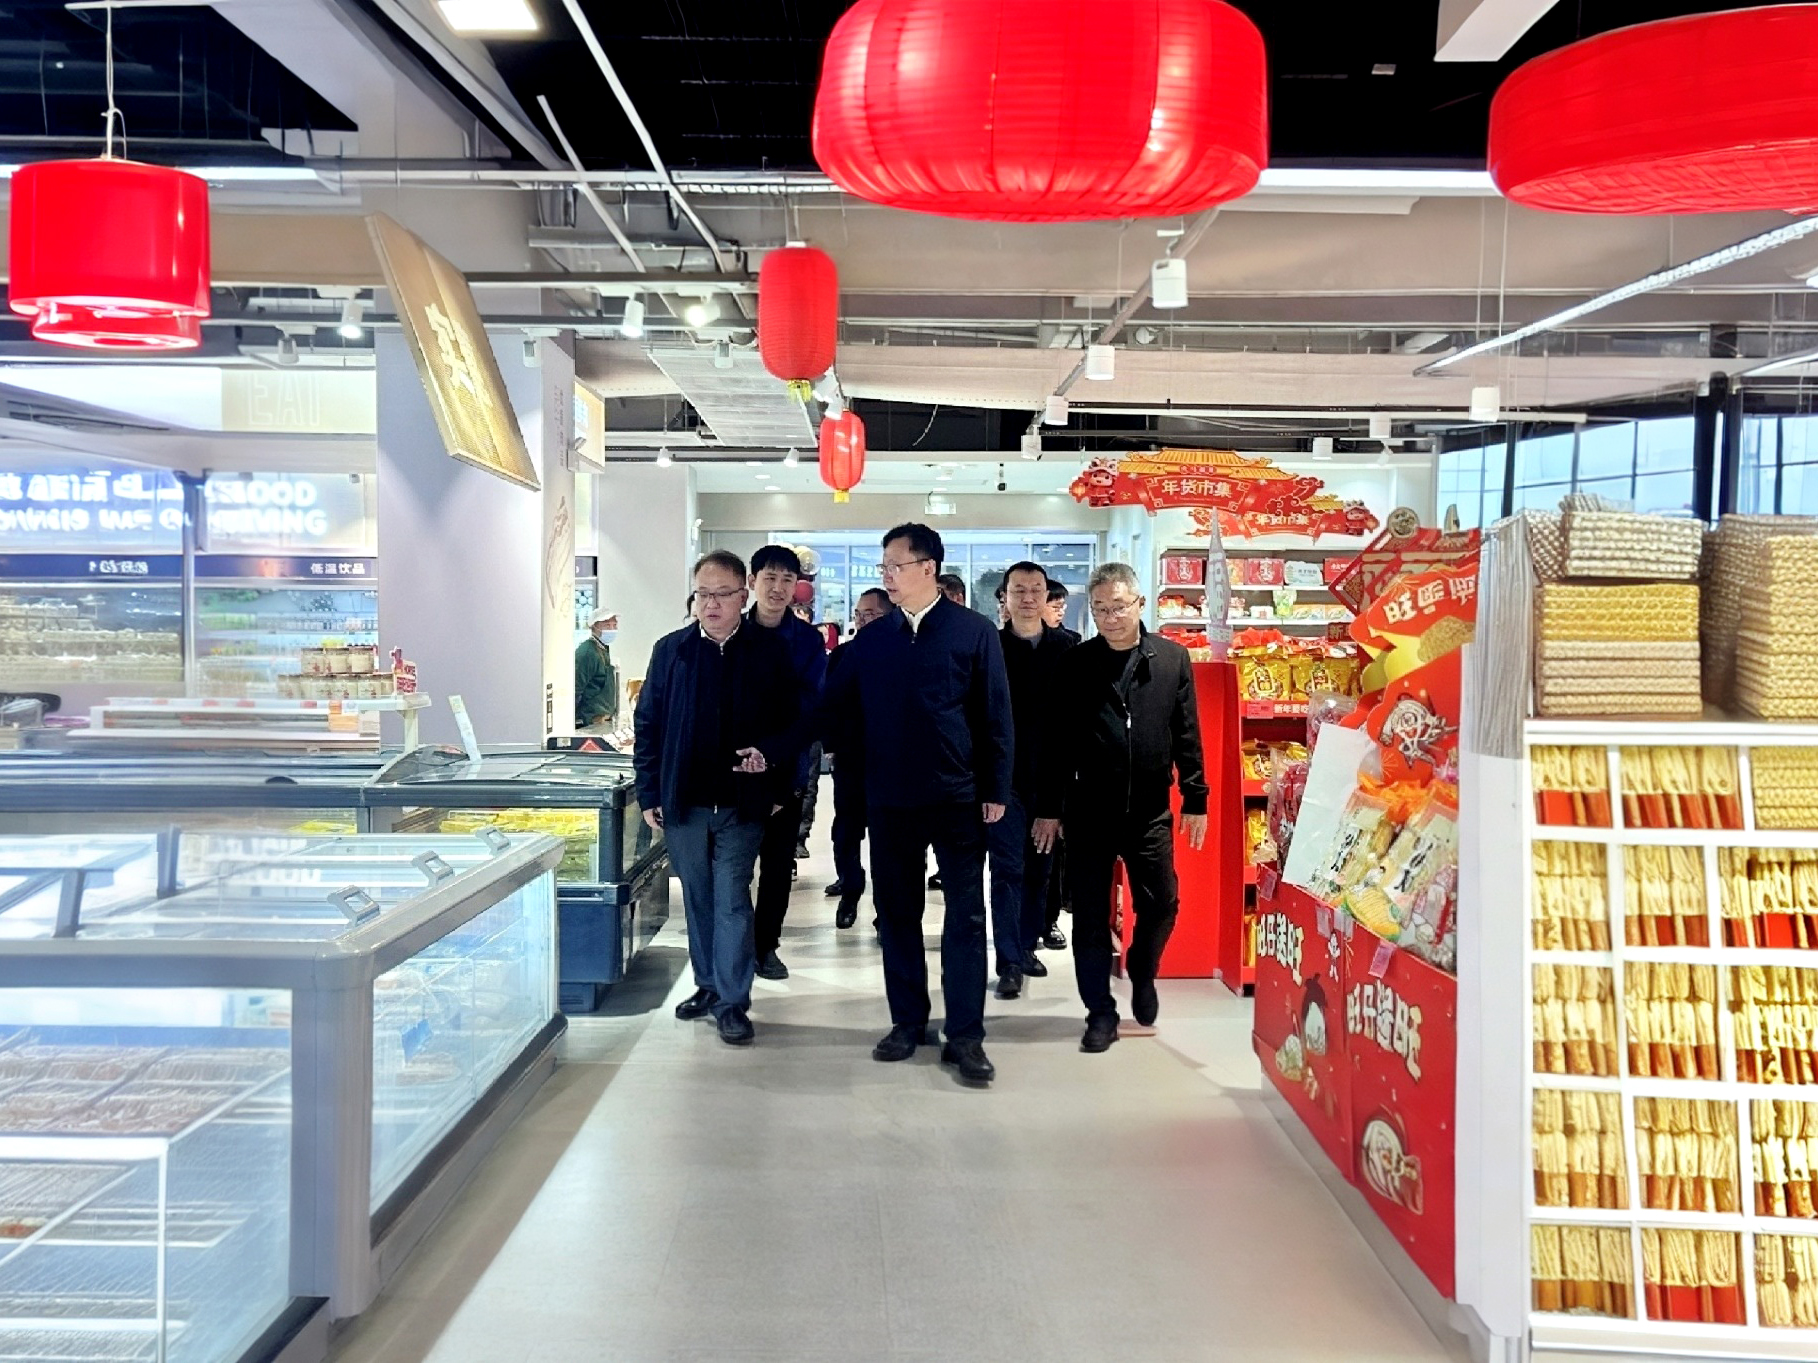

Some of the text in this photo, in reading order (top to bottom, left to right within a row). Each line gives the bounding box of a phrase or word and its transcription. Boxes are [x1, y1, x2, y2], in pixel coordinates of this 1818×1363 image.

[1162, 478, 1232, 498] 年货市集
[310, 562, 366, 575] 低温饮品
